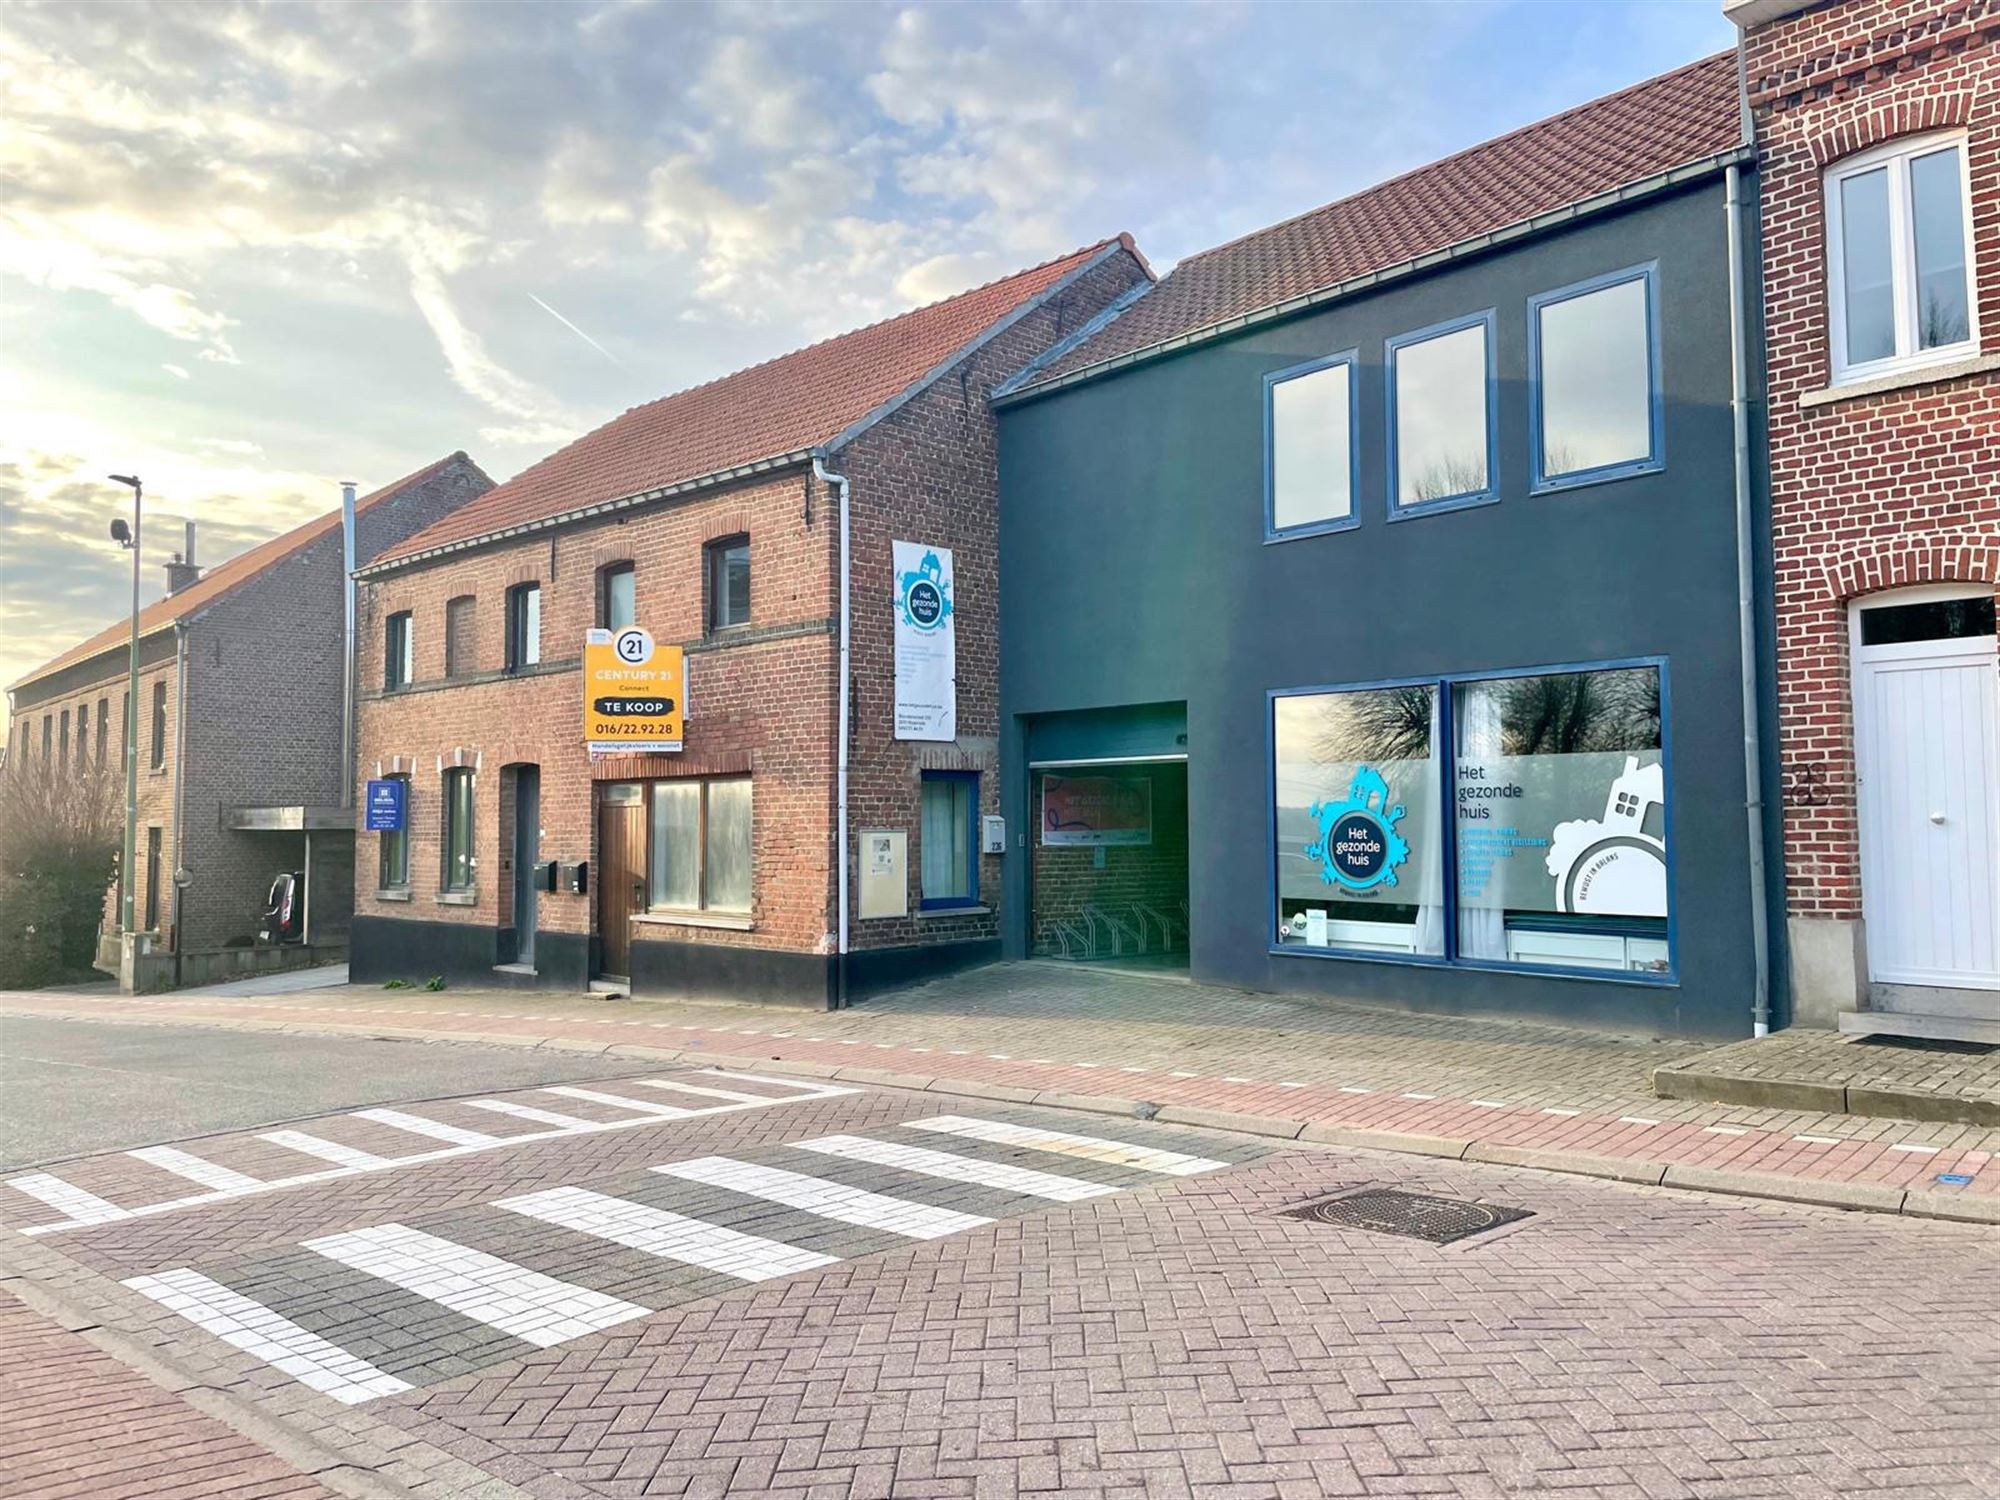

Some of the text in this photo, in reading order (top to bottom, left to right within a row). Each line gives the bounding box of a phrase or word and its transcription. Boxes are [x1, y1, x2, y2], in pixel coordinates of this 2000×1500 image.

[919, 590, 931, 599] Het
[912, 599, 938, 608] gezonde
[918, 607, 932, 616] huis
[595, 670, 672, 680] CENTURY 21
[604, 702, 664, 712] TE KOOP
[595, 724, 673, 735] 016/22.92.28
[1458, 766, 1485, 779] Het
[1458, 782, 1524, 802] gezonde
[1459, 803, 1490, 819] huis
[1348, 827, 1368, 839] Het
[1336, 840, 1381, 854] gezonde
[1347, 853, 1370, 865] huis
[1579, 874, 1593, 900] BEWUST
[1595, 852, 1619, 870] BALANS
